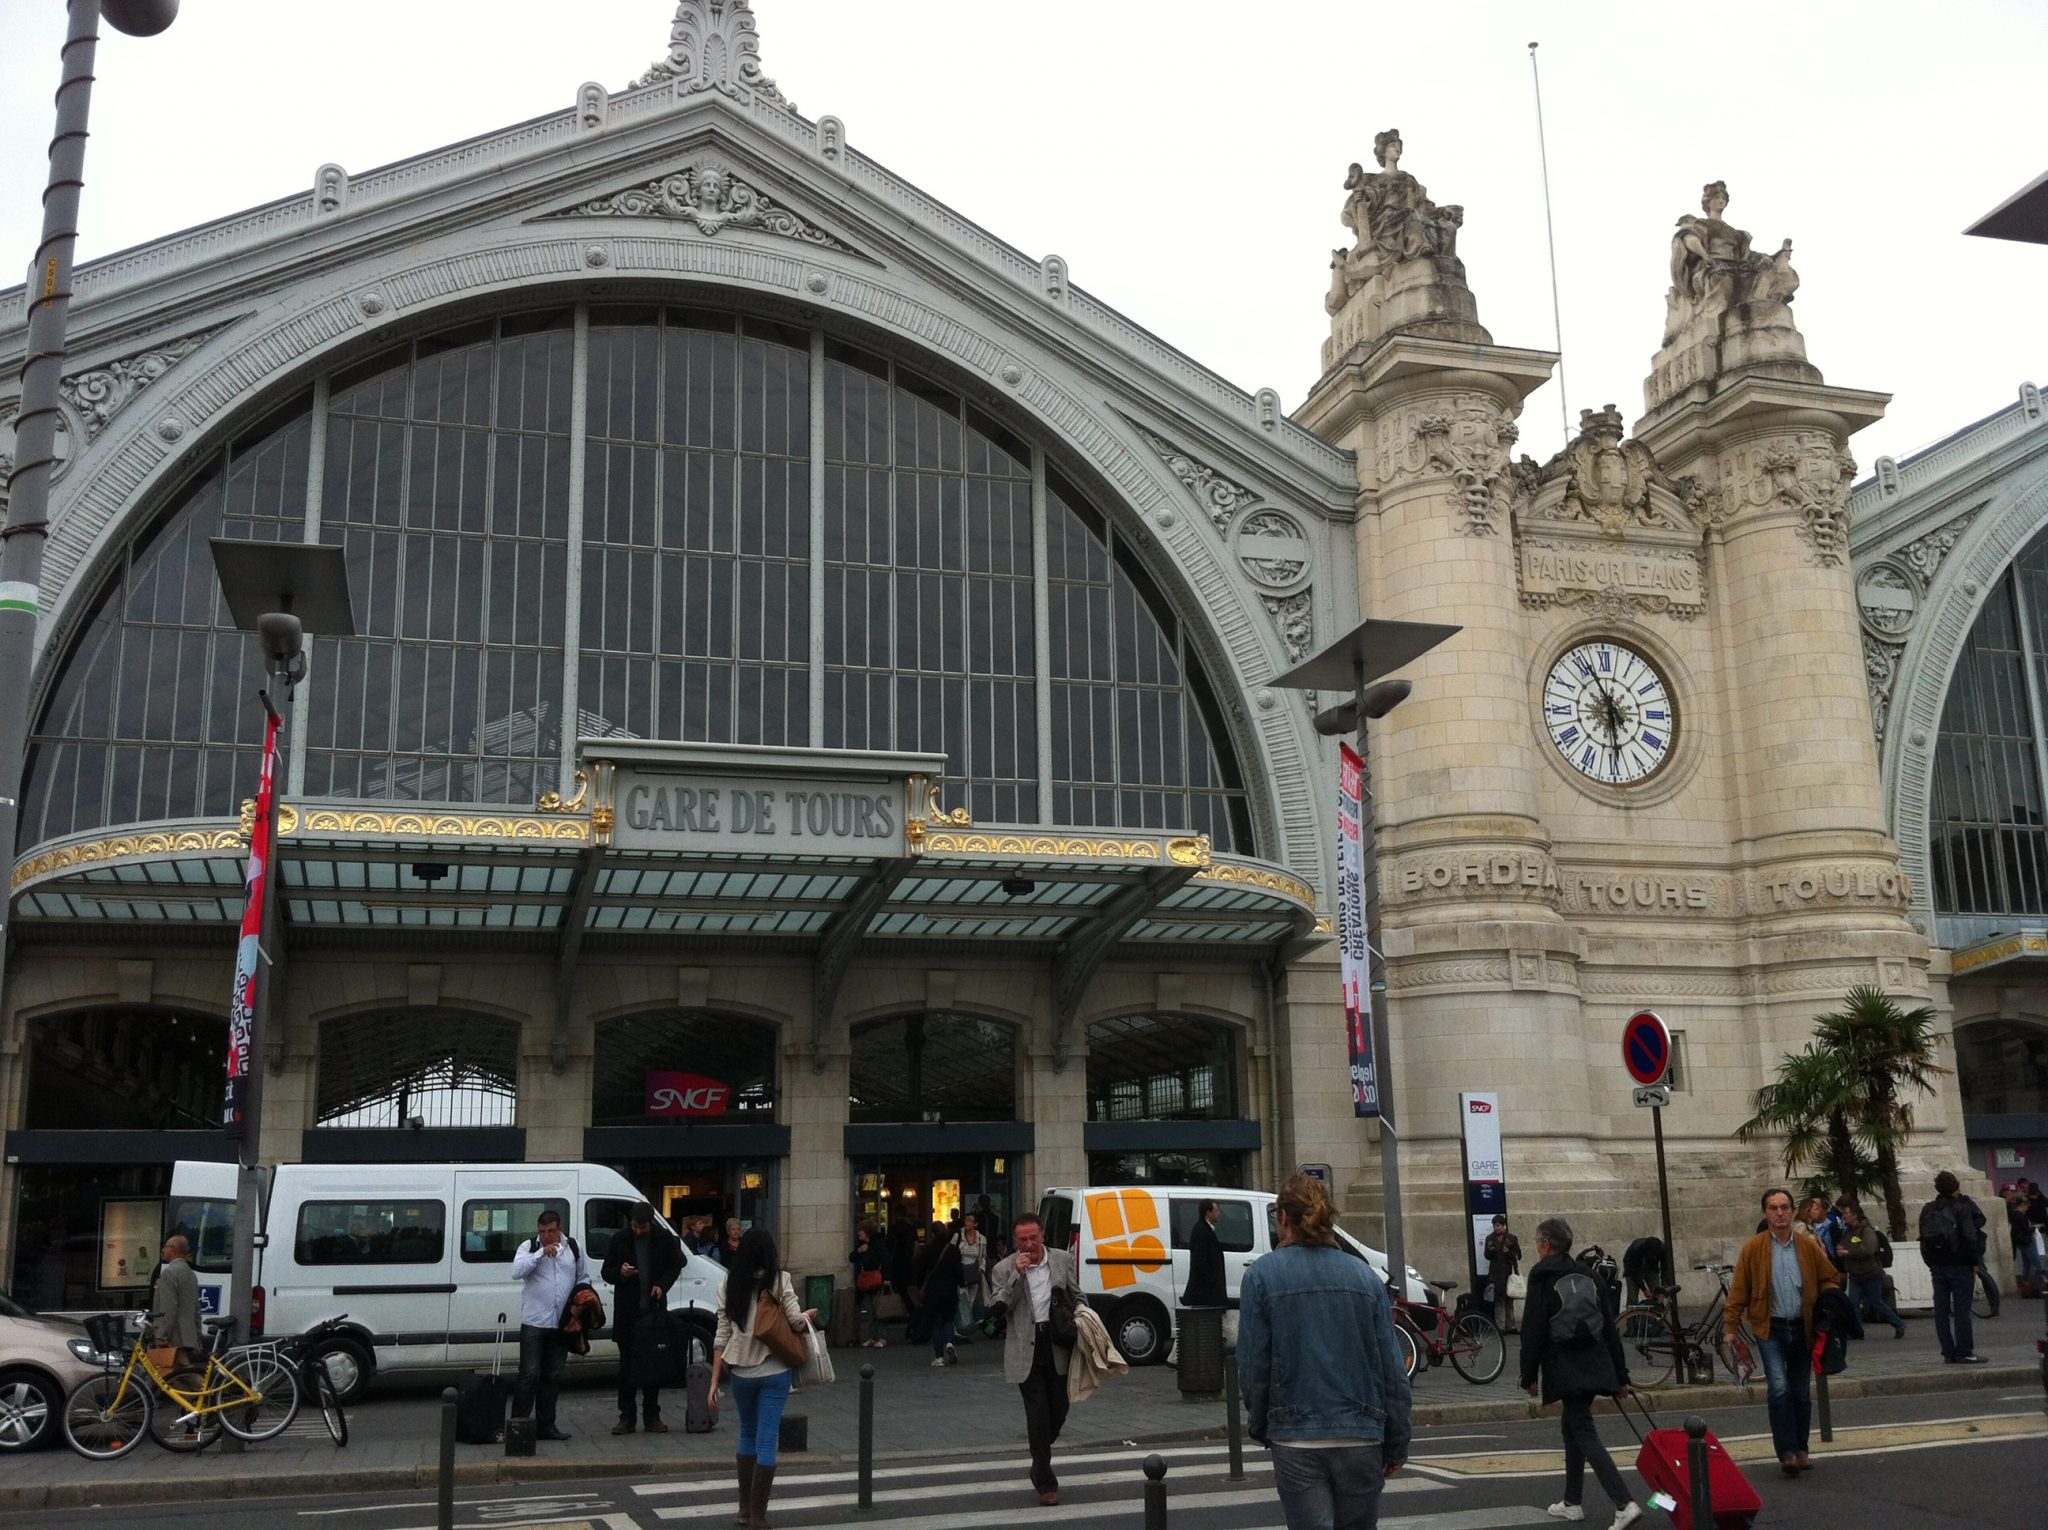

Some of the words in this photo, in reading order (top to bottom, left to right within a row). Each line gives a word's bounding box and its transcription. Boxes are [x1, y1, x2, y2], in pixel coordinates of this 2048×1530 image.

[625, 783, 721, 833] GARE
[730, 788, 777, 835] DE
[785, 791, 896, 839] TOURS
[1580, 878, 1707, 908] TOURS
[650, 1087, 727, 1110] SNCF
[1471, 1104, 1491, 1113] SNCF
[1471, 1160, 1499, 1170] GARE
